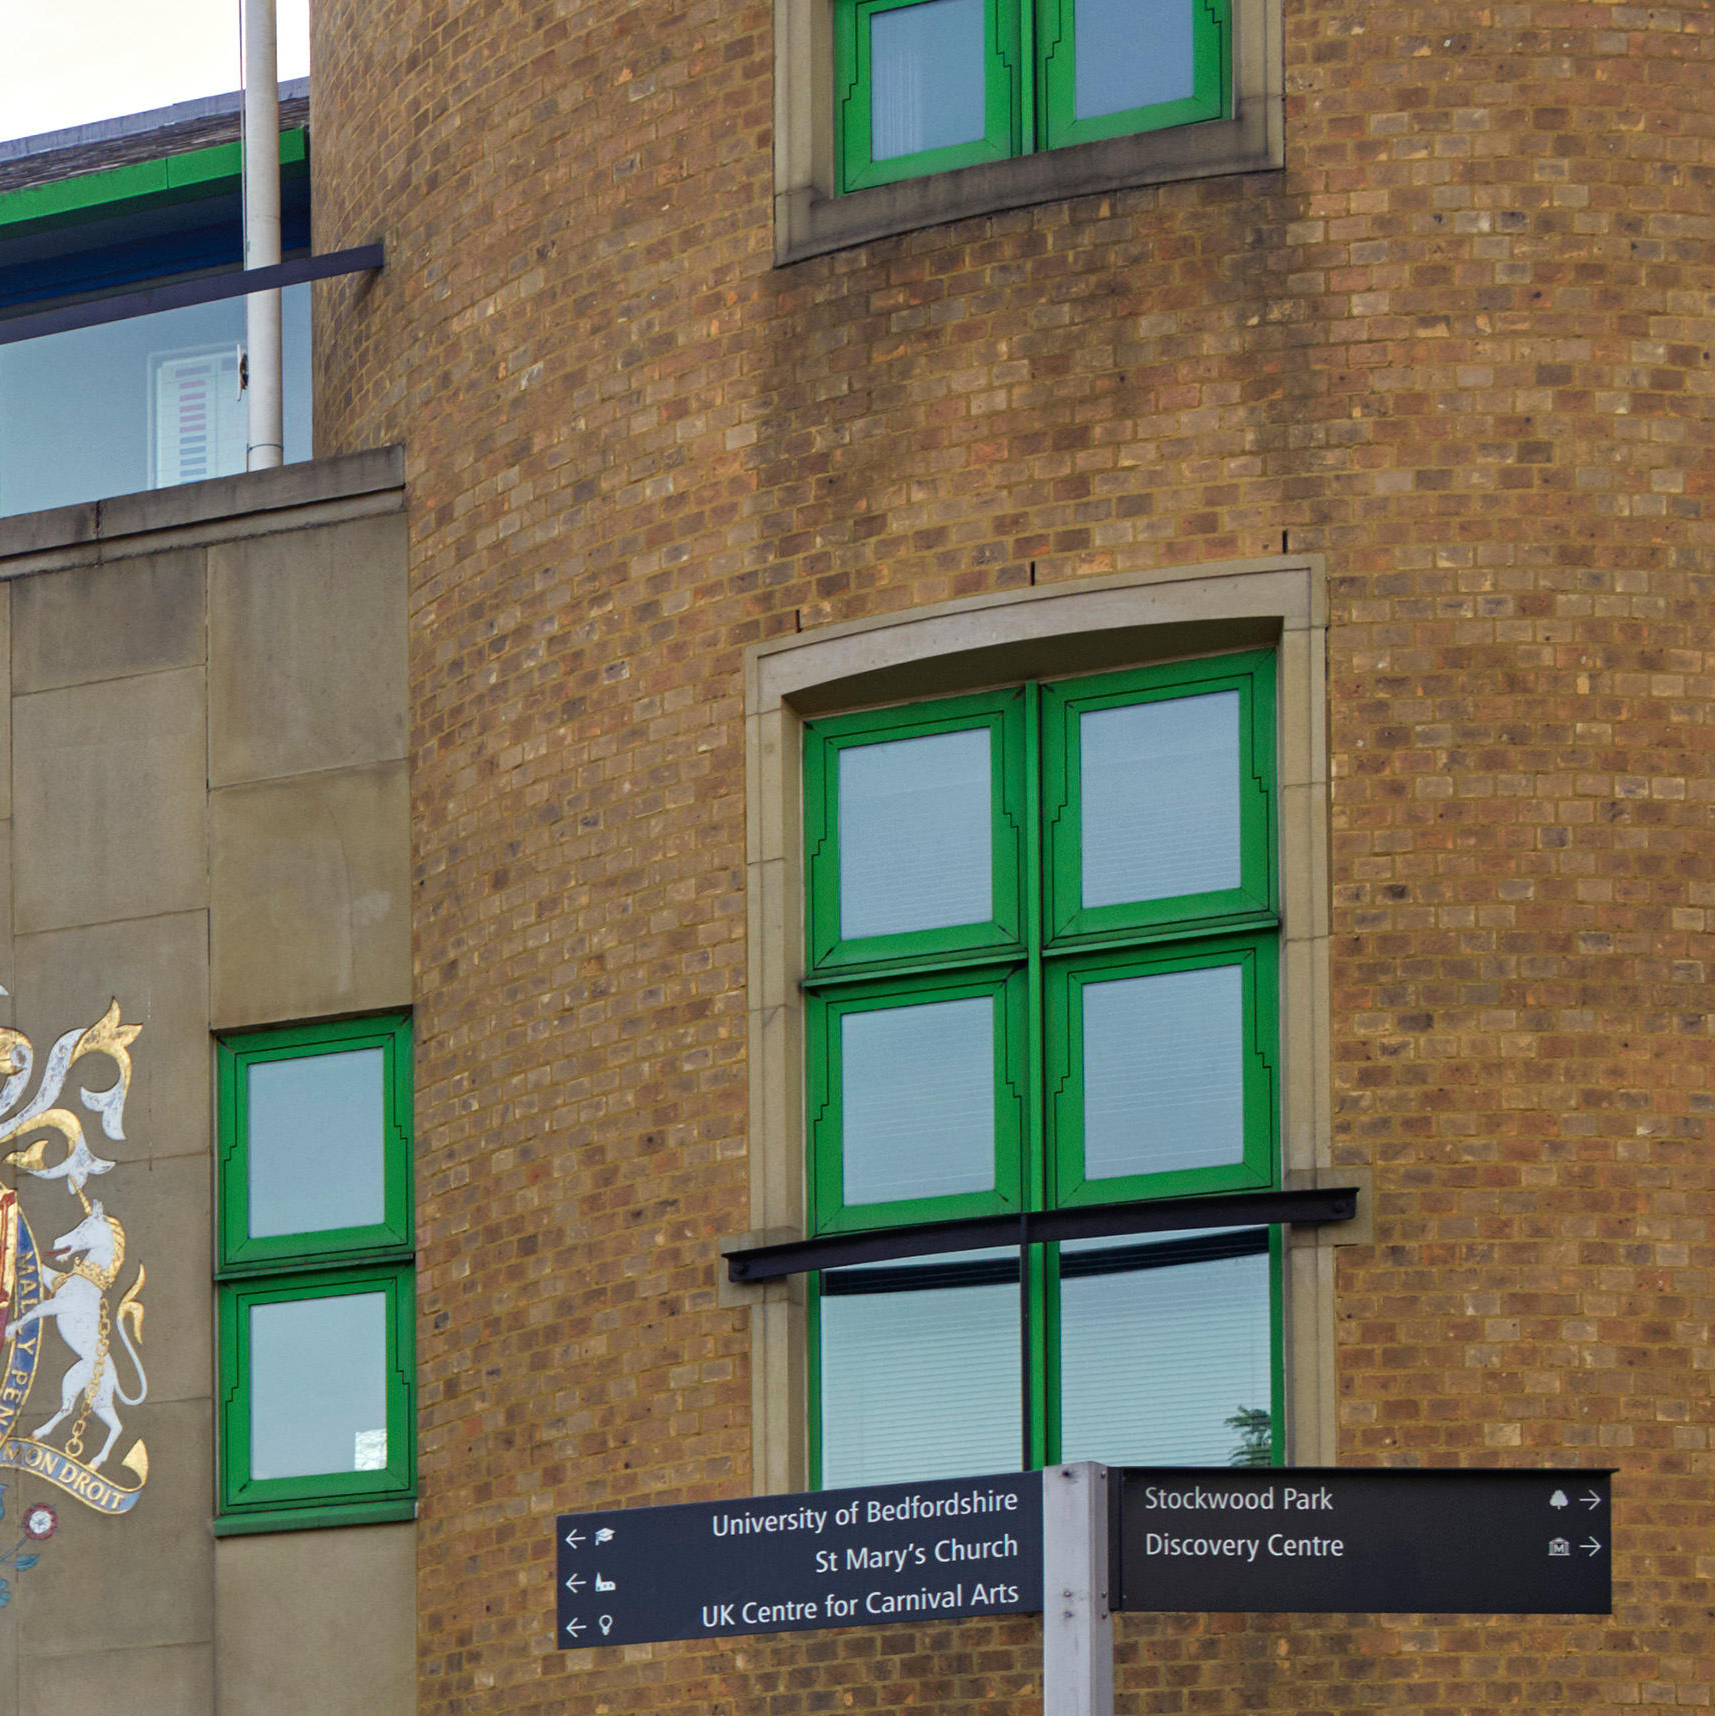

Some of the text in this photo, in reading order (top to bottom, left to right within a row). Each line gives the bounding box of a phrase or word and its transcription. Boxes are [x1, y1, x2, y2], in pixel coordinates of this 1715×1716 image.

[17, 1337, 37, 1355] Y
[2, 1442, 59, 1475] MON
[57, 1461, 126, 1510] DROIT
[712, 1489, 1018, 1537] University of Bedfordshire
[1145, 1486, 1334, 1510] Stockwood Park
[815, 1550, 839, 1574] St
[934, 1533, 1018, 1563] Church
[1146, 1532, 1344, 1563] Discovery Centre
[702, 1583, 1019, 1628] UK Centre for Carnival Arts
